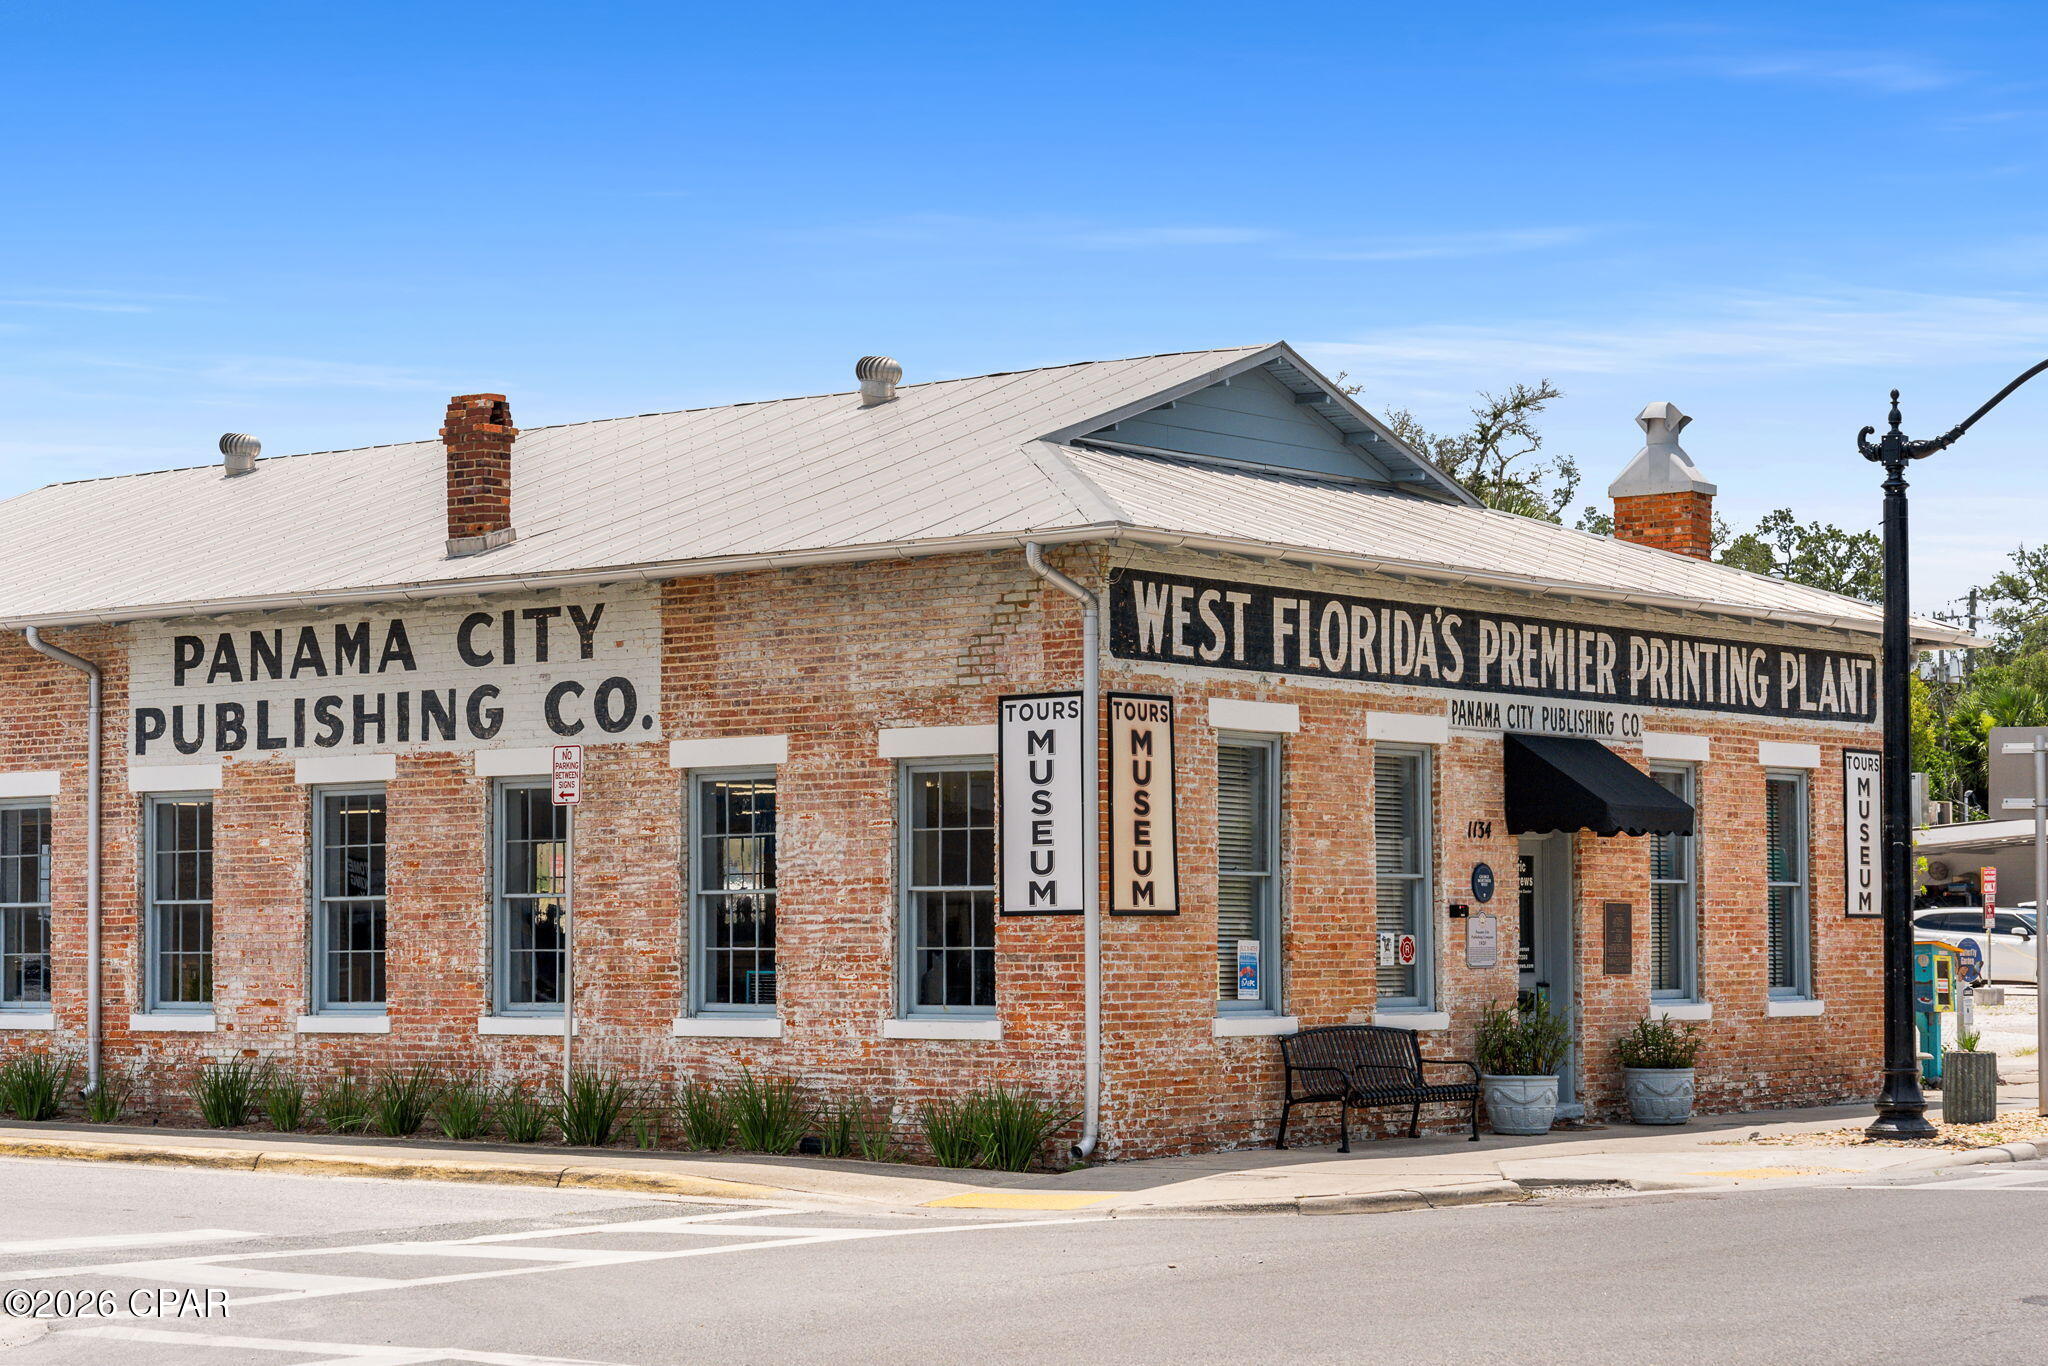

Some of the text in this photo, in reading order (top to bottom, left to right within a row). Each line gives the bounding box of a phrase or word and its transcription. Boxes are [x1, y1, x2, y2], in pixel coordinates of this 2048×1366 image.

[174, 603, 605, 686] PANAMA CITY
[1133, 580, 1872, 715] WEST FLORIDA'S PREMIER PRINTING PLANT
[135, 676, 653, 755] PUBLISHING CO.
[1005, 700, 1079, 722] TOURS
[1113, 701, 1168, 723] TOURS
[1452, 699, 1641, 737] PANAMA CITY PUBLISHING CO.
[555, 762, 579, 770] PARKING
[562, 751, 572, 760] NO
[1847, 755, 1879, 772] TOURS
[555, 771, 579, 779] BETWEEN
[558, 781, 575, 789] SIGNS
[1027, 728, 1057, 907] MUSEUM
[1131, 729, 1155, 907] MUSEUM
[1467, 821, 1491, 838] 1134
[1857, 777, 1871, 911] MUSEUM
